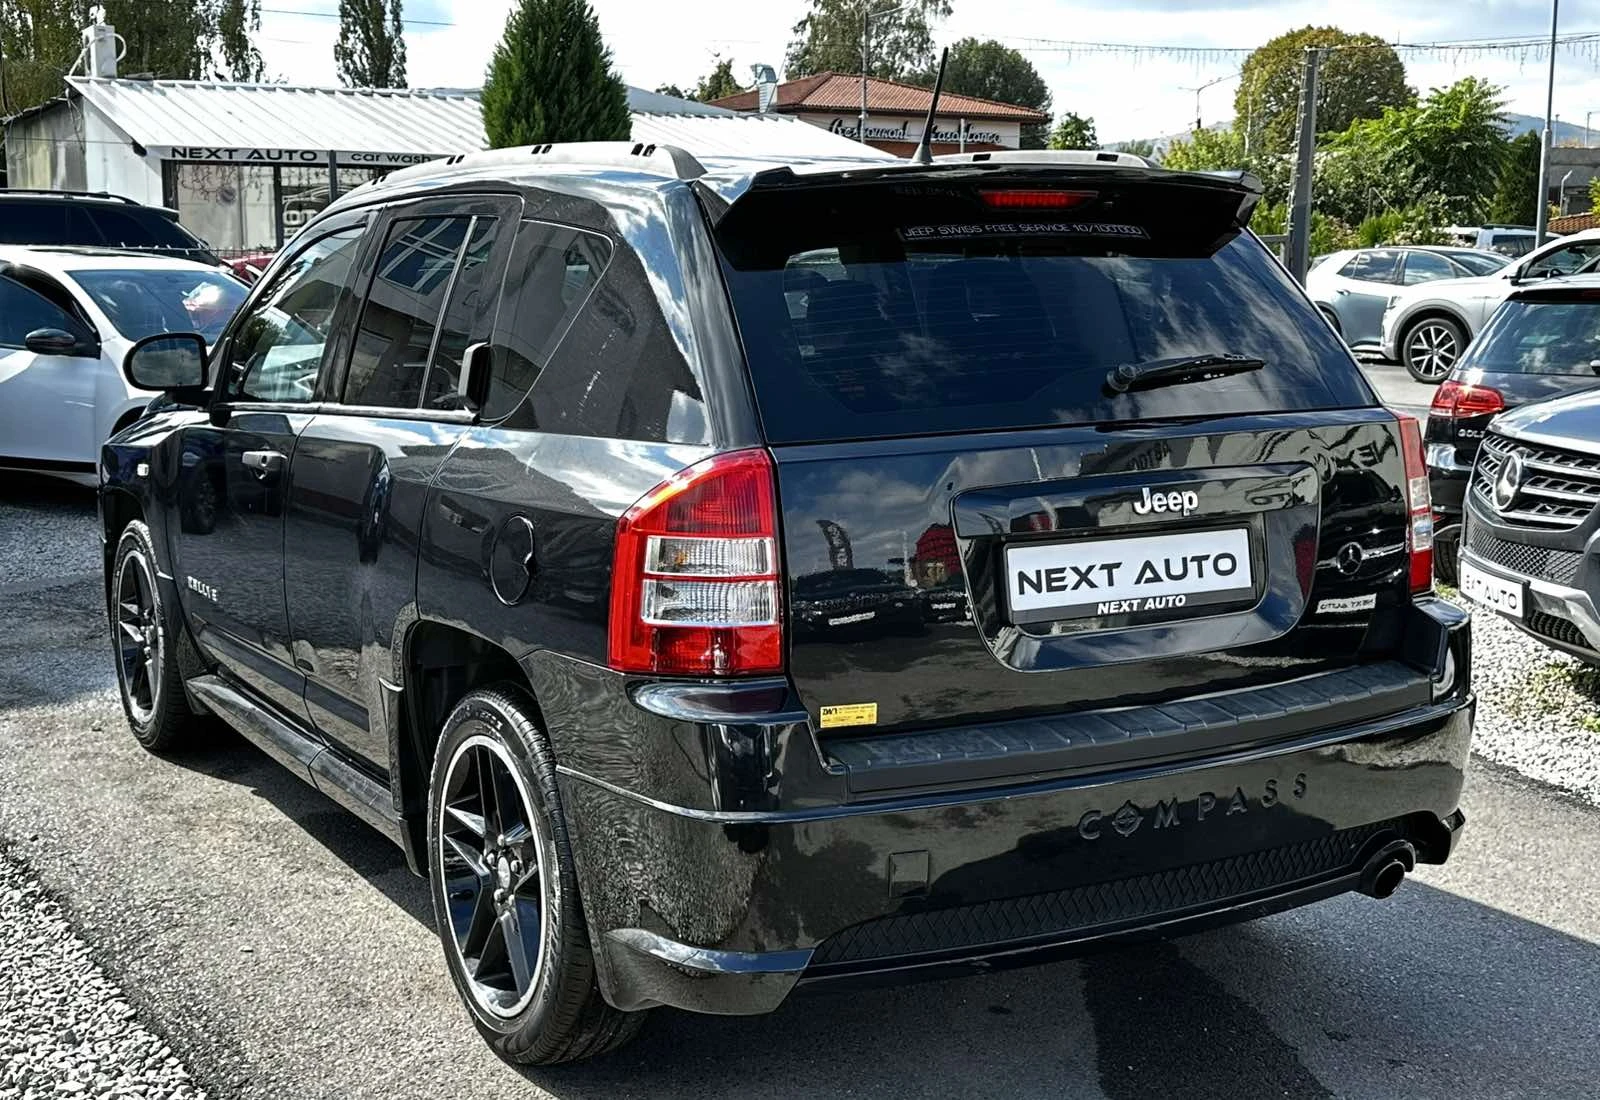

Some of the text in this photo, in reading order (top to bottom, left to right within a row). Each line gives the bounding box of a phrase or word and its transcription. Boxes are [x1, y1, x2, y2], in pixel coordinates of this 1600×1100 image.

[171, 147, 317, 162] NEXT AUTO
[351, 152, 432, 164] car wash
[905, 226, 935, 237] JEEP
[1133, 487, 1199, 516] Jeep
[1017, 552, 1238, 596] NEXT AUTO
[1097, 594, 1187, 616] NEXT AUTO
[1078, 772, 1307, 841] COMPASS
